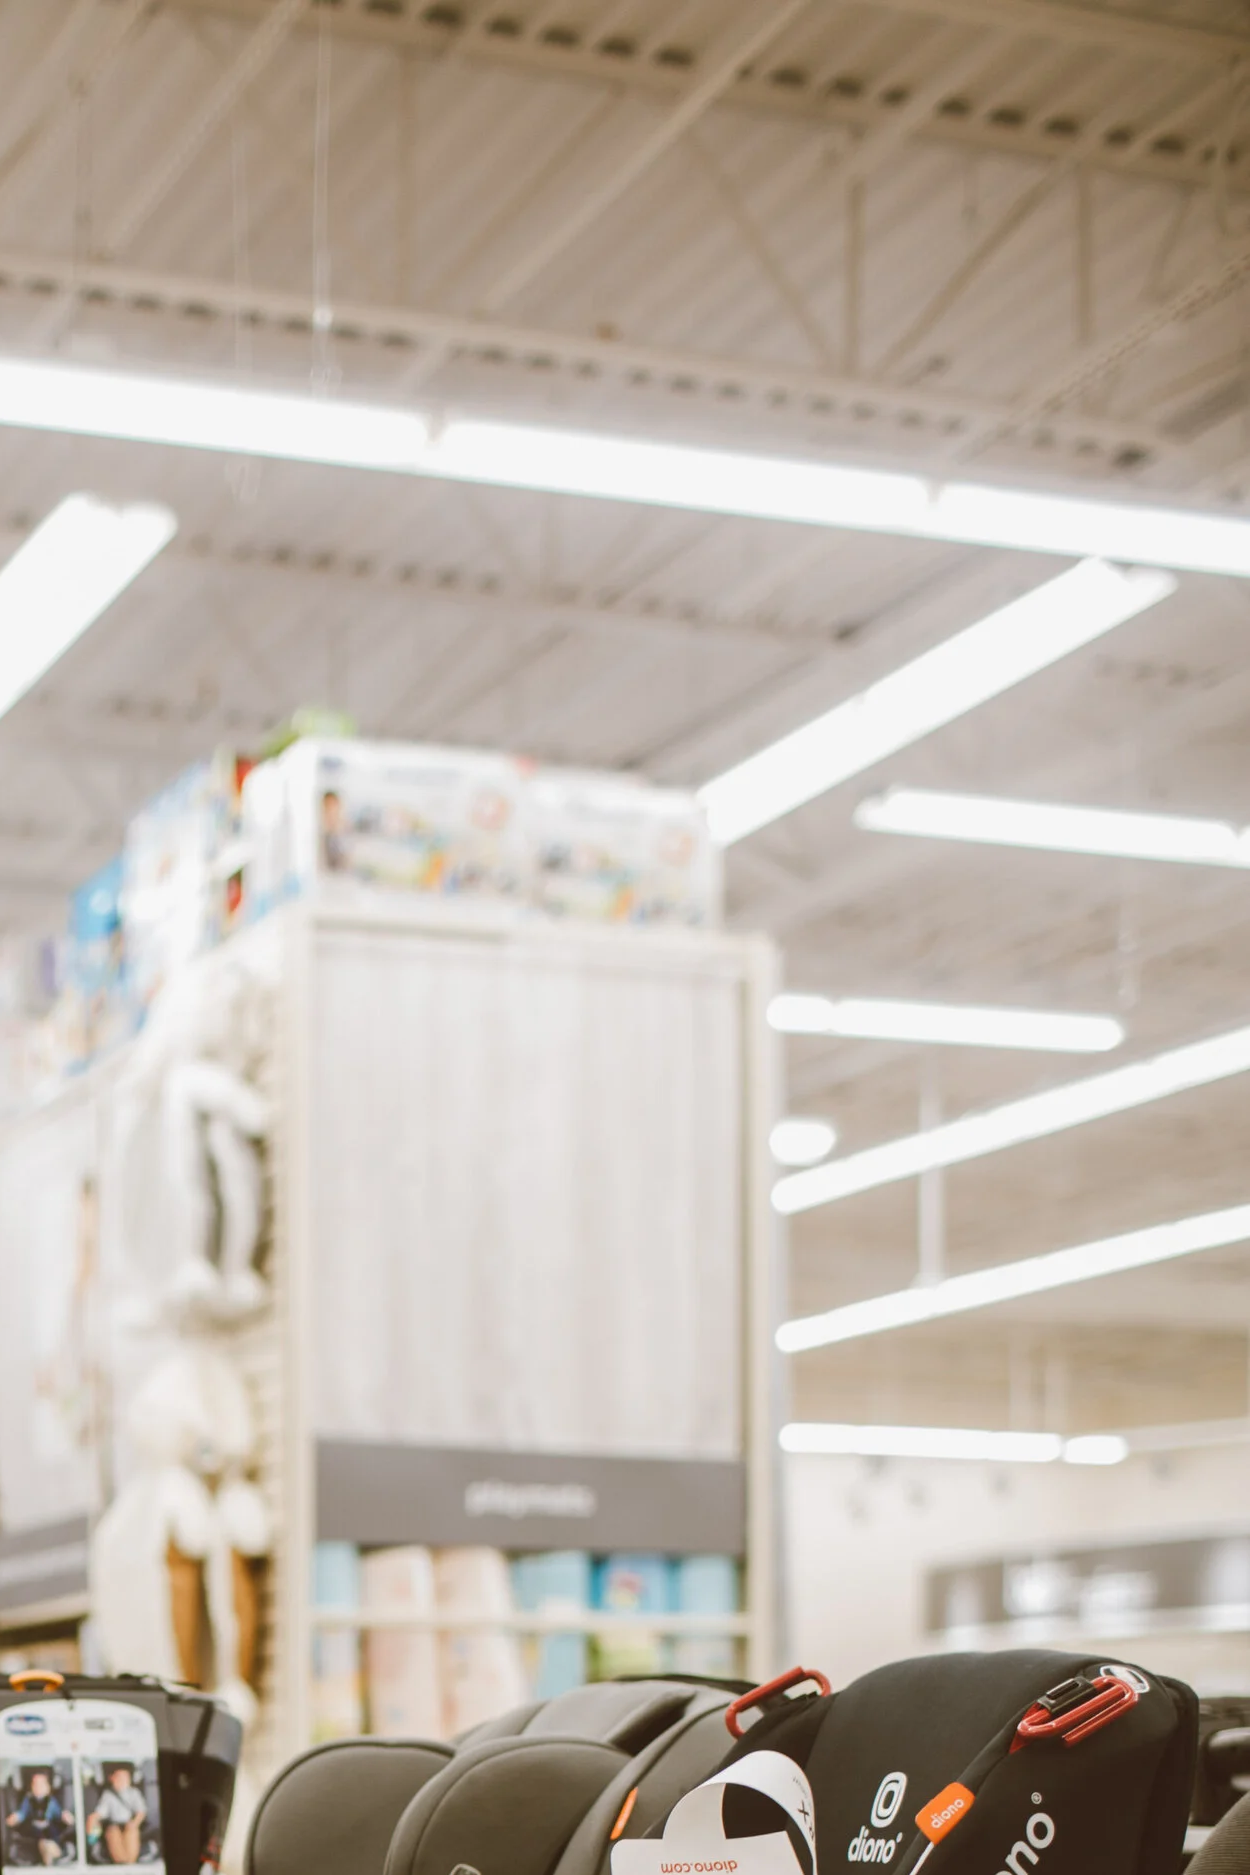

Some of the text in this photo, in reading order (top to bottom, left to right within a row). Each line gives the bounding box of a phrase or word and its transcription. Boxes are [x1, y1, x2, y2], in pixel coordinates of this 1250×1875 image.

[931, 1797, 965, 1830] diono
[847, 1825, 897, 1864] diono
[660, 1859, 739, 1874] diono.com
